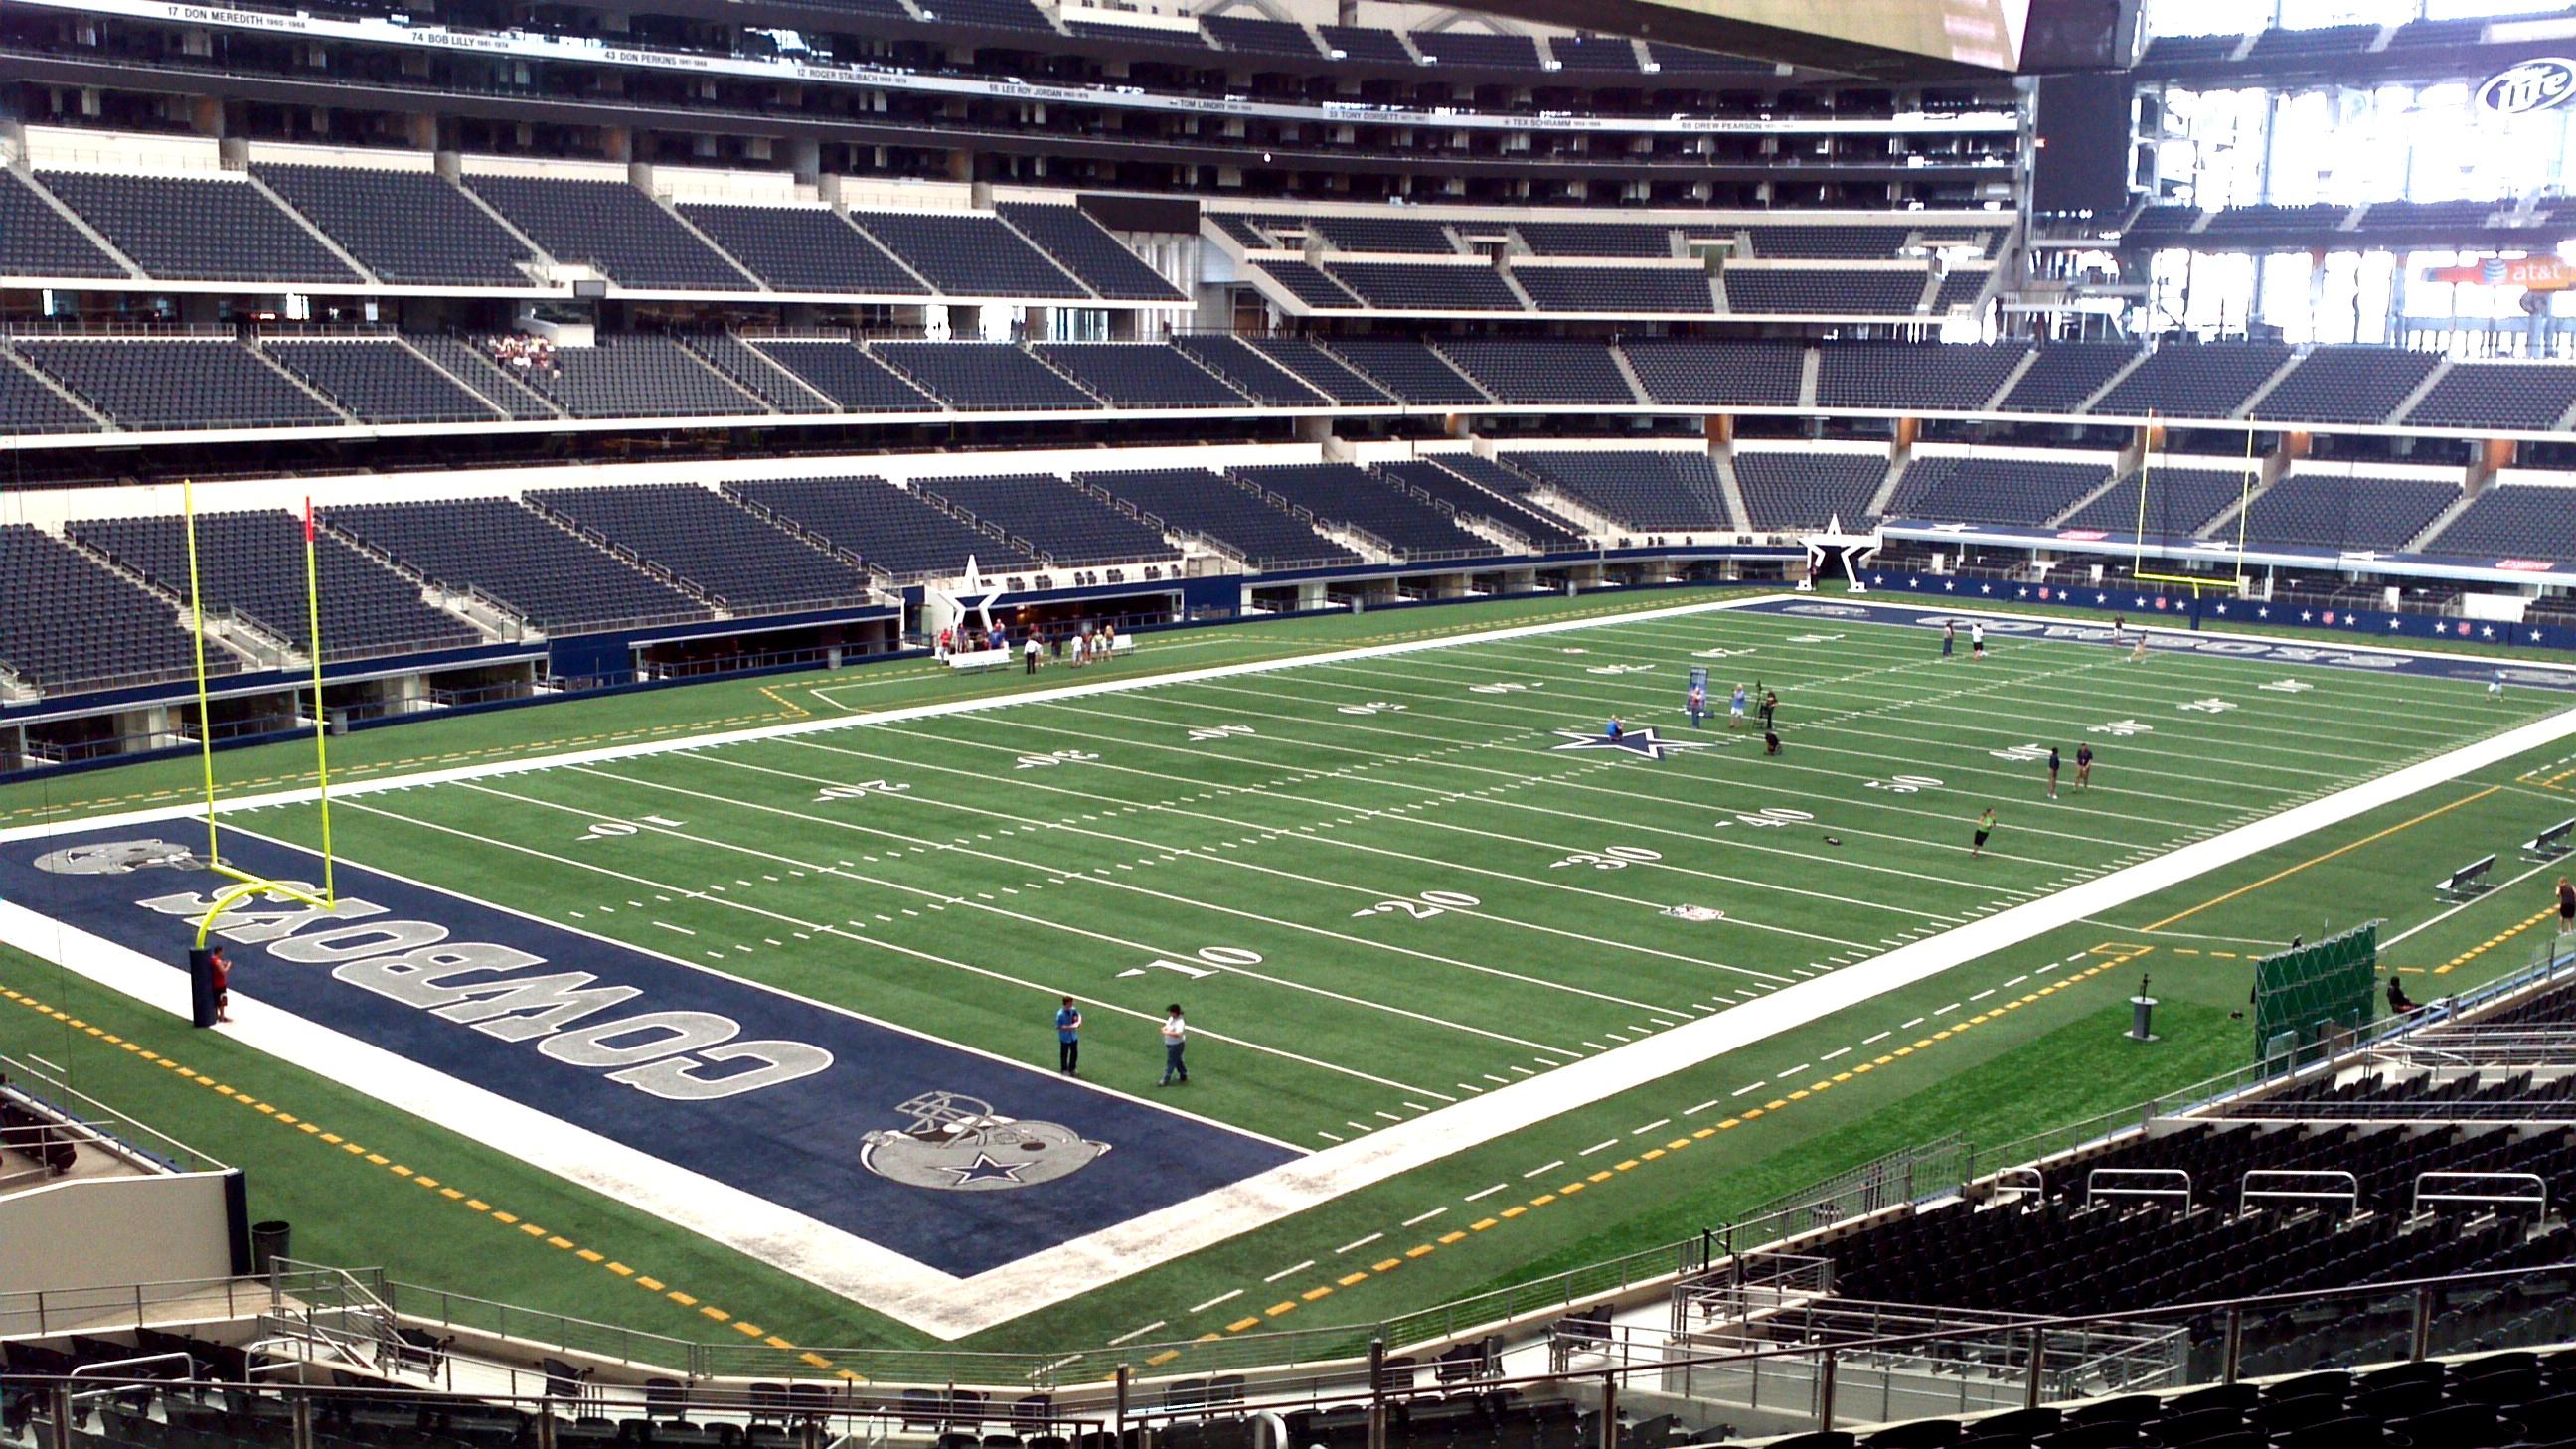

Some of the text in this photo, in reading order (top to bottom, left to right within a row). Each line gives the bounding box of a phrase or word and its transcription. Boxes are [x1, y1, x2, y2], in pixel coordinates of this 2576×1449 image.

[168, 7, 178, 17] 17
[185, 8, 207, 19] DON
[211, 11, 263, 25] MEREDITH
[412, 32, 424, 42] 74
[428, 33, 449, 45] BOB
[451, 36, 475, 47] LILLY
[604, 50, 616, 60] 43
[620, 52, 638, 63] DON
[641, 54, 677, 66] PERKINS
[797, 68, 806, 78] 12
[809, 69, 836, 80] ROGER
[838, 71, 878, 81] STAUBACH
[1002, 85, 1015, 94] LEE
[1017, 86, 1031, 95] ROY
[1034, 87, 1062, 98] JORDAN
[1180, 99, 1195, 108] TOM
[1198, 100, 1225, 110] LANDRY
[1342, 110, 1361, 119] TONY
[1364, 111, 1398, 120] DORSETT
[1694, 121, 1719, 130] DREW
[1721, 121, 1762, 130] PEARSON
[2513, 263, 2561, 281] at&t
[819, 779, 911, 798] 20
[587, 814, 690, 836] 10
[1735, 808, 1815, 827] 40
[1566, 846, 1663, 870] 30
[1374, 890, 1481, 919] 20
[1146, 946, 1264, 980] 10
[134, 881, 834, 1100] COWBOYS
